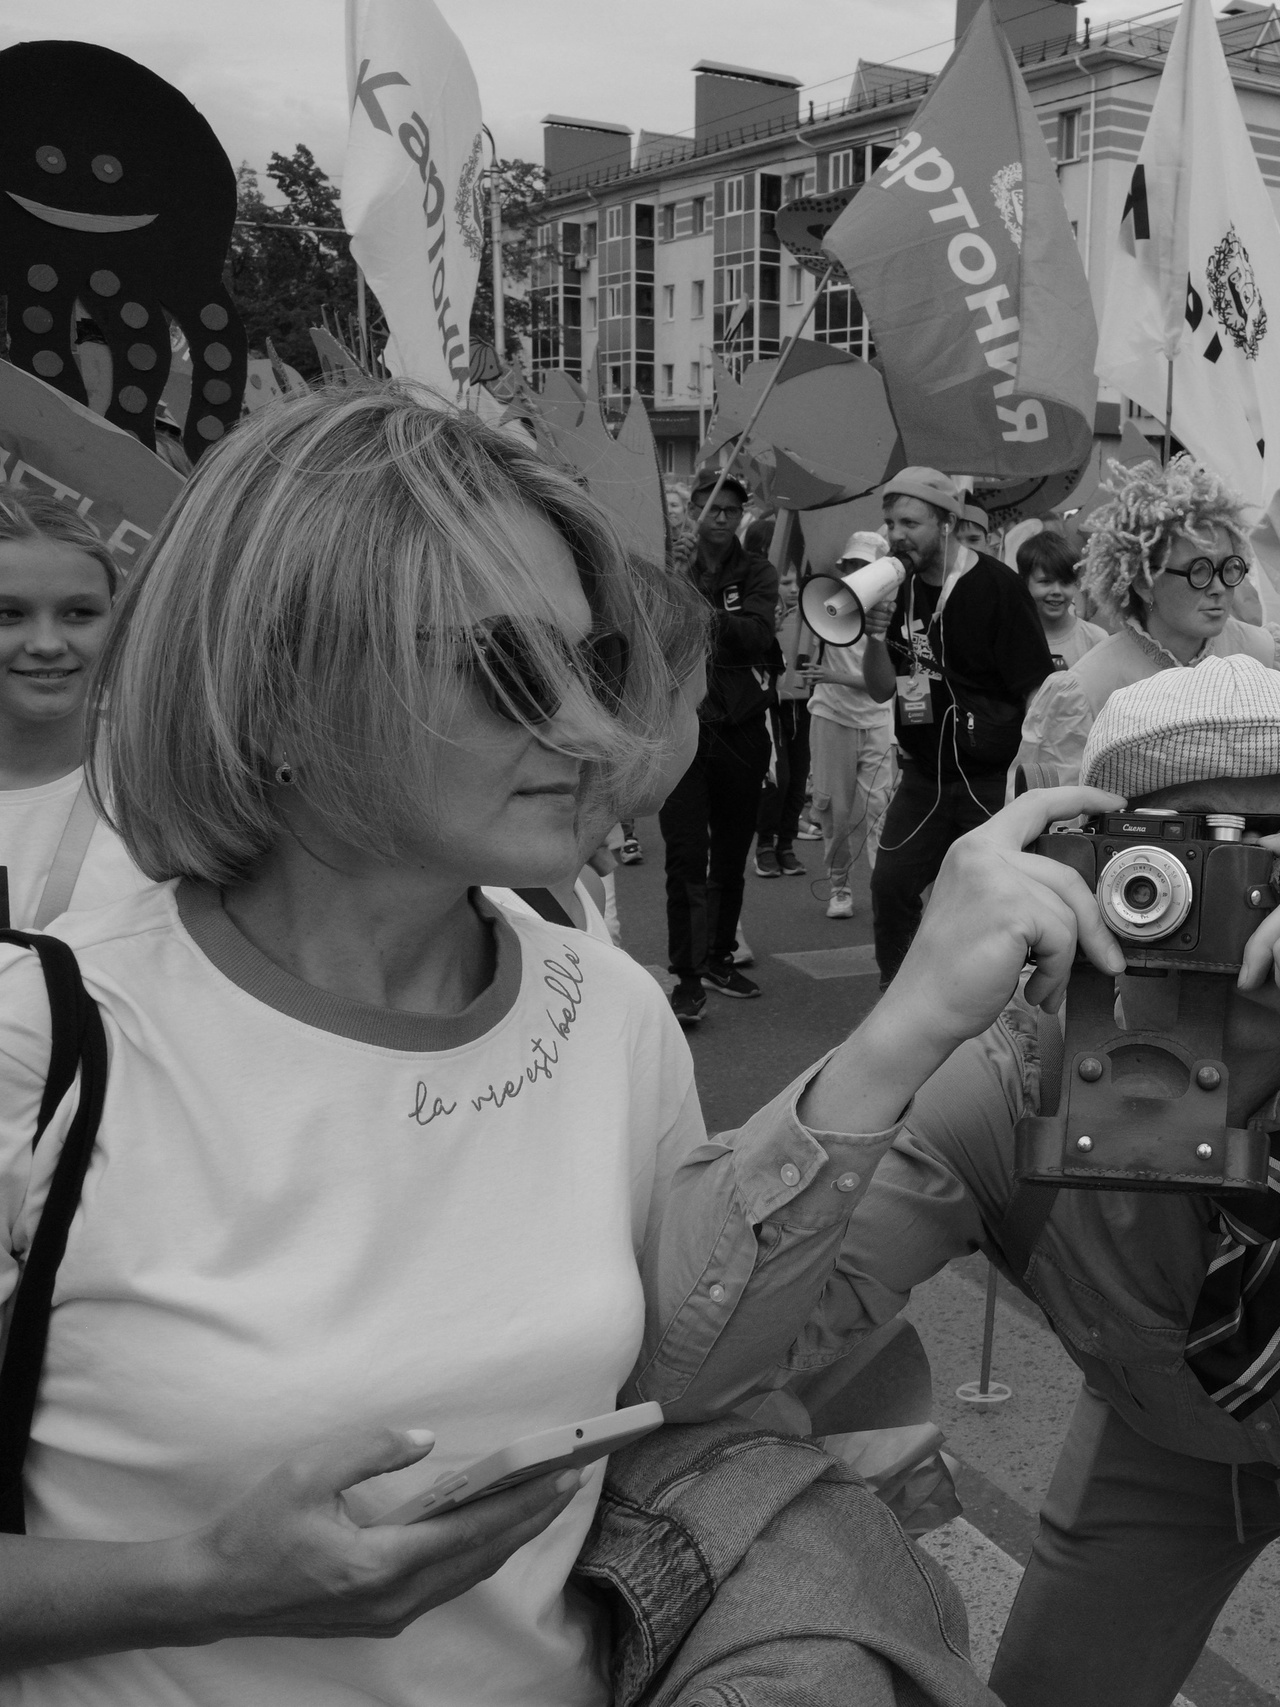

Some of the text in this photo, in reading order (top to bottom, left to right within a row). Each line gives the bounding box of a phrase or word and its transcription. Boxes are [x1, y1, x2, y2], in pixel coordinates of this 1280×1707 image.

[1123, 824, 1147, 832] Смена
[408, 944, 584, 1126] la vie est belle
